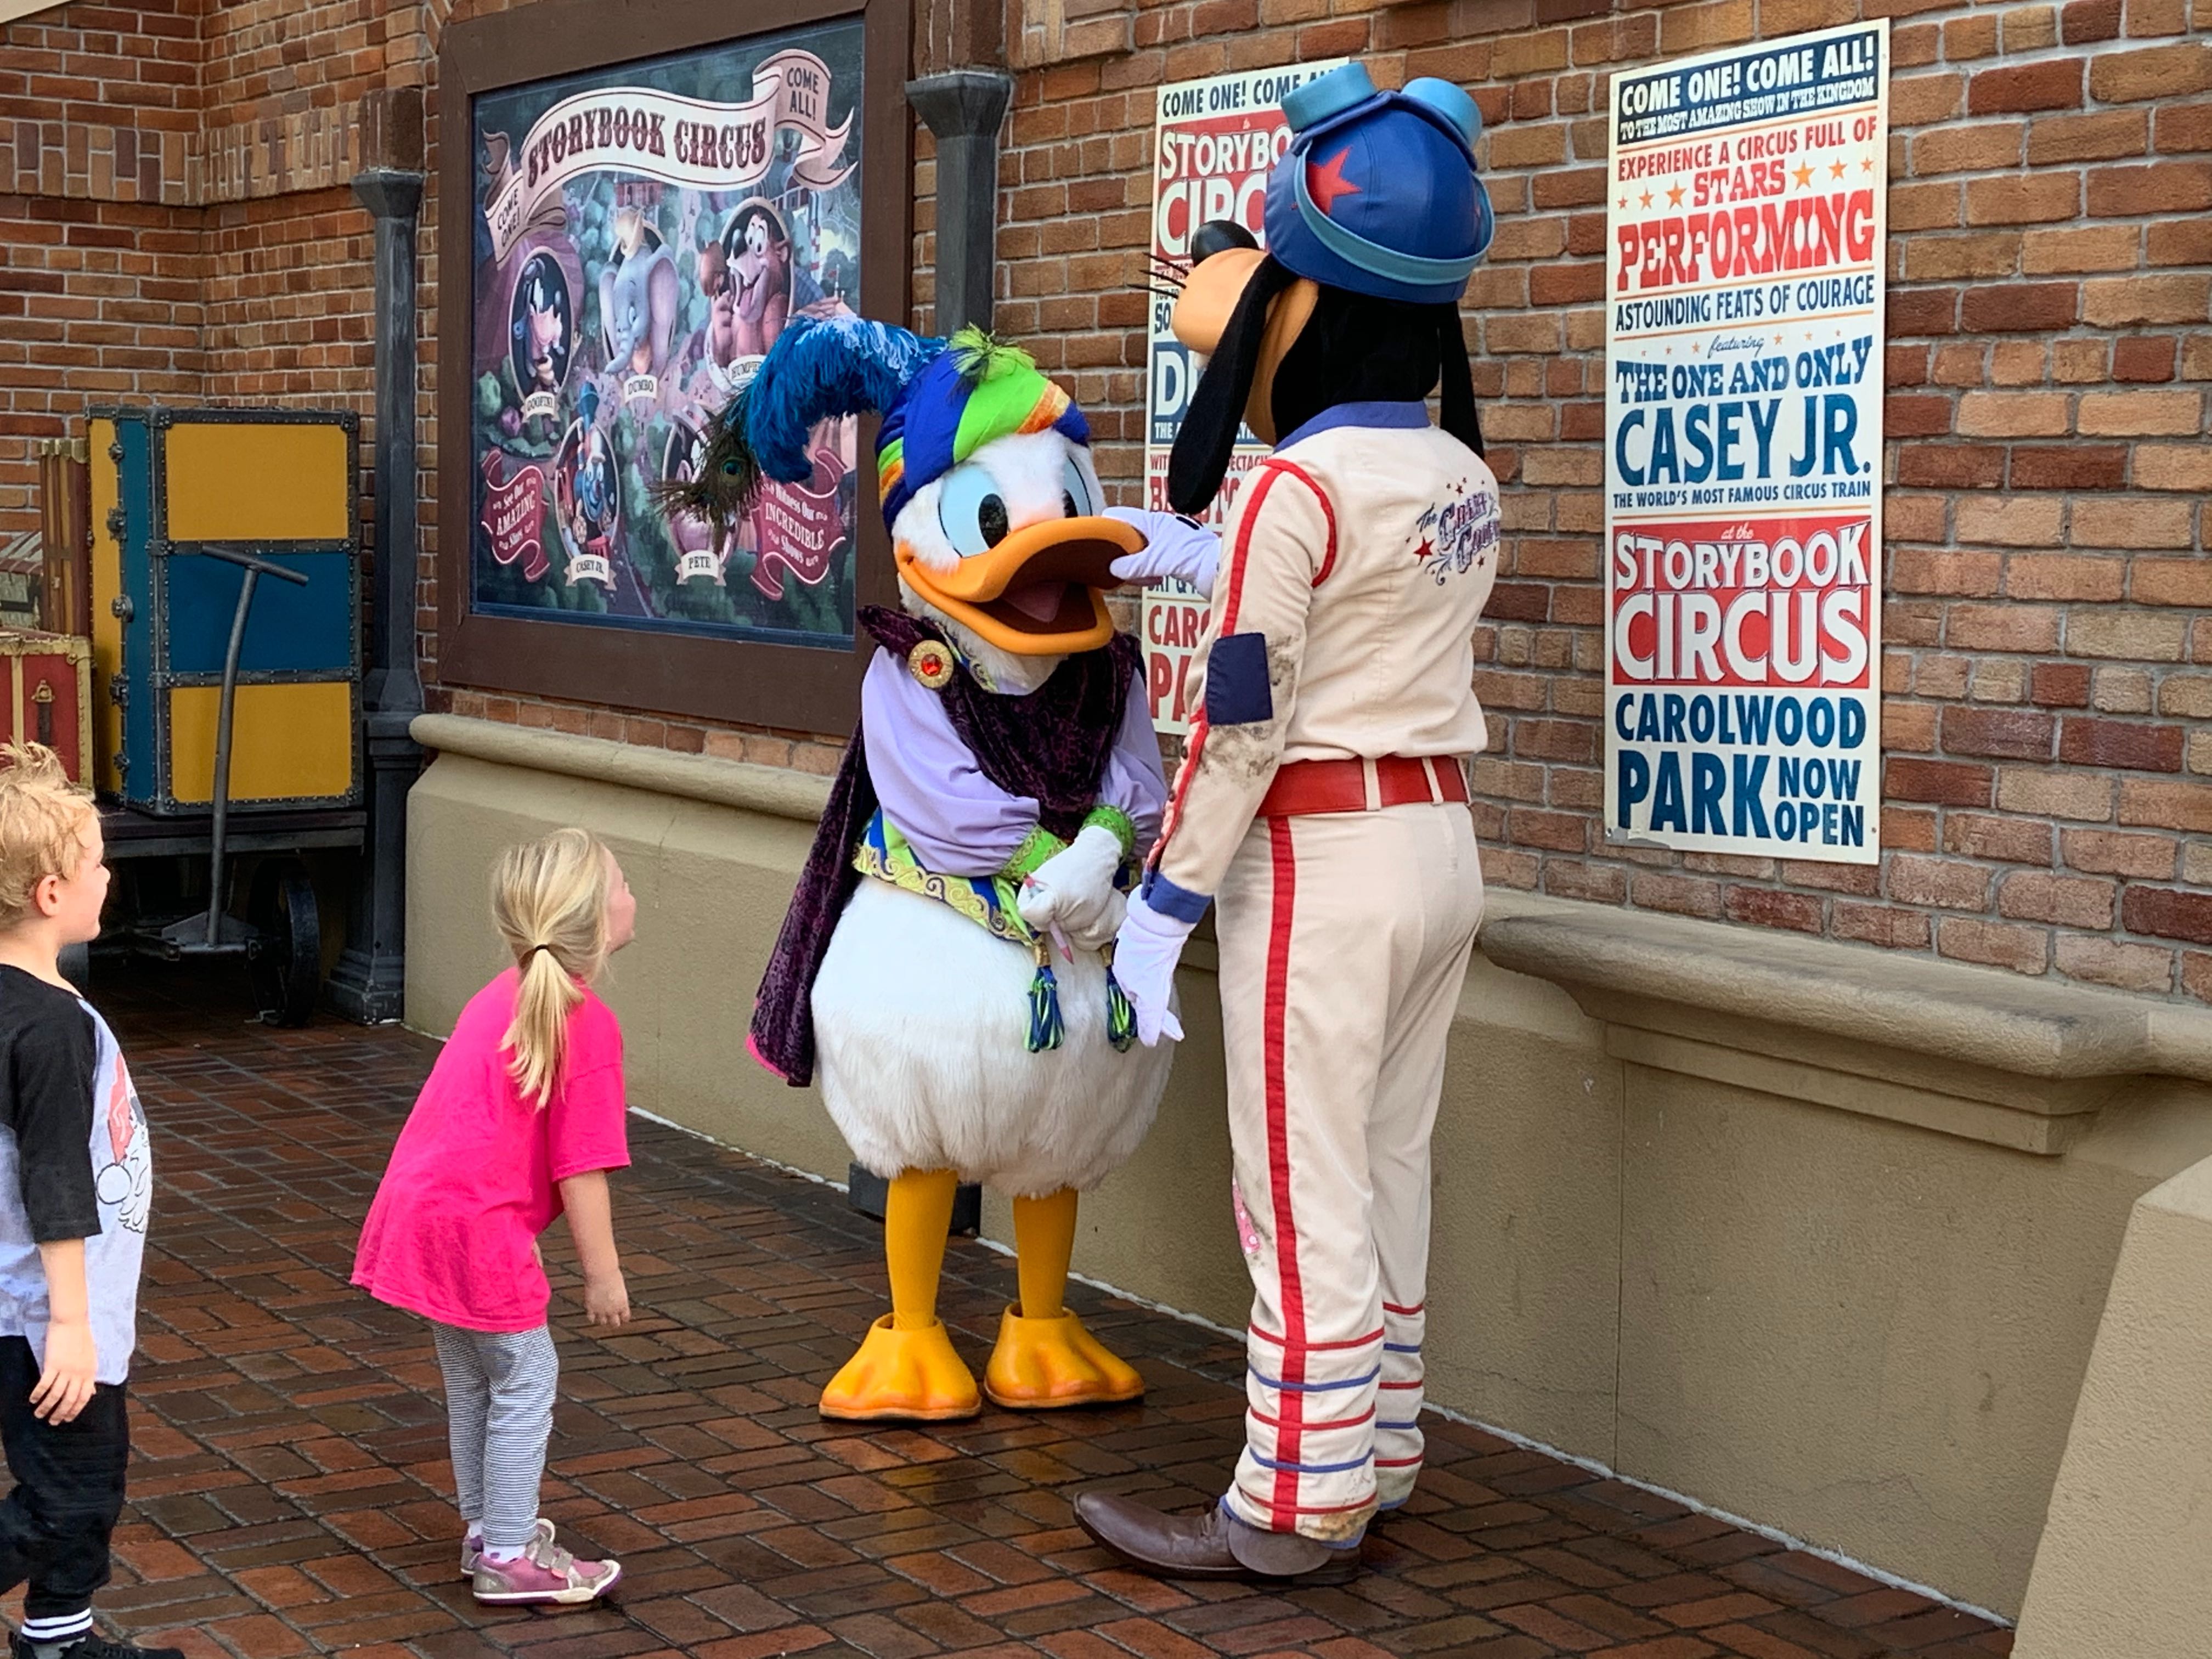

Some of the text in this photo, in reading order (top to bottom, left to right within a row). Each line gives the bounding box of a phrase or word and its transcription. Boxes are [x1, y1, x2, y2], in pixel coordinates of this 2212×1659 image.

[787, 67, 819, 95] COME
[1163, 88, 1204, 117] COME
[1209, 80, 1246, 111] ONE!
[1621, 36, 1874, 116] COME ONE! COME ALL!
[789, 90, 816, 121] ALL!
[1620, 76, 1875, 140] TO THE MOST AMAZING SHOW IN THE KINGDOM
[528, 105, 766, 188] STORYBOOK CIRCUS
[1161, 126, 1296, 180] STORYBO
[1618, 116, 1877, 182] EXPERIENCE A CIRCUS FULL OF
[1693, 159, 1786, 207] STARS
[1158, 173, 1268, 257] CIRC
[1617, 189, 1875, 291] PERFORMING
[1616, 274, 1875, 332] ASTOUNDING FEATS OF COURAGE
[1707, 334, 1765, 359] featuring
[1616, 360, 1668, 404] THE
[1672, 363, 1724, 399] ONE
[1728, 356, 1790, 394] AND
[1154, 422, 1173, 439] THE
[1615, 393, 1871, 487] CASEY JR.
[1150, 454, 1169, 471] WIT
[496, 489, 536, 536] AMAZING
[1613, 481, 1871, 509] THE WORLD'S MOST FAMOUS CIRCUS TRAIN
[765, 501, 825, 551] INCREDIBLE
[1720, 522, 1755, 540] at the
[688, 556, 711, 569] PETE
[1616, 518, 1872, 591] STORYBOOK
[1613, 587, 1870, 687] CIRCUS
[1615, 692, 1866, 749] CAROLWOOD
[1618, 749, 1771, 839] PARK
[1778, 755, 1862, 802] NOW
[1774, 800, 1865, 848] OPEN
